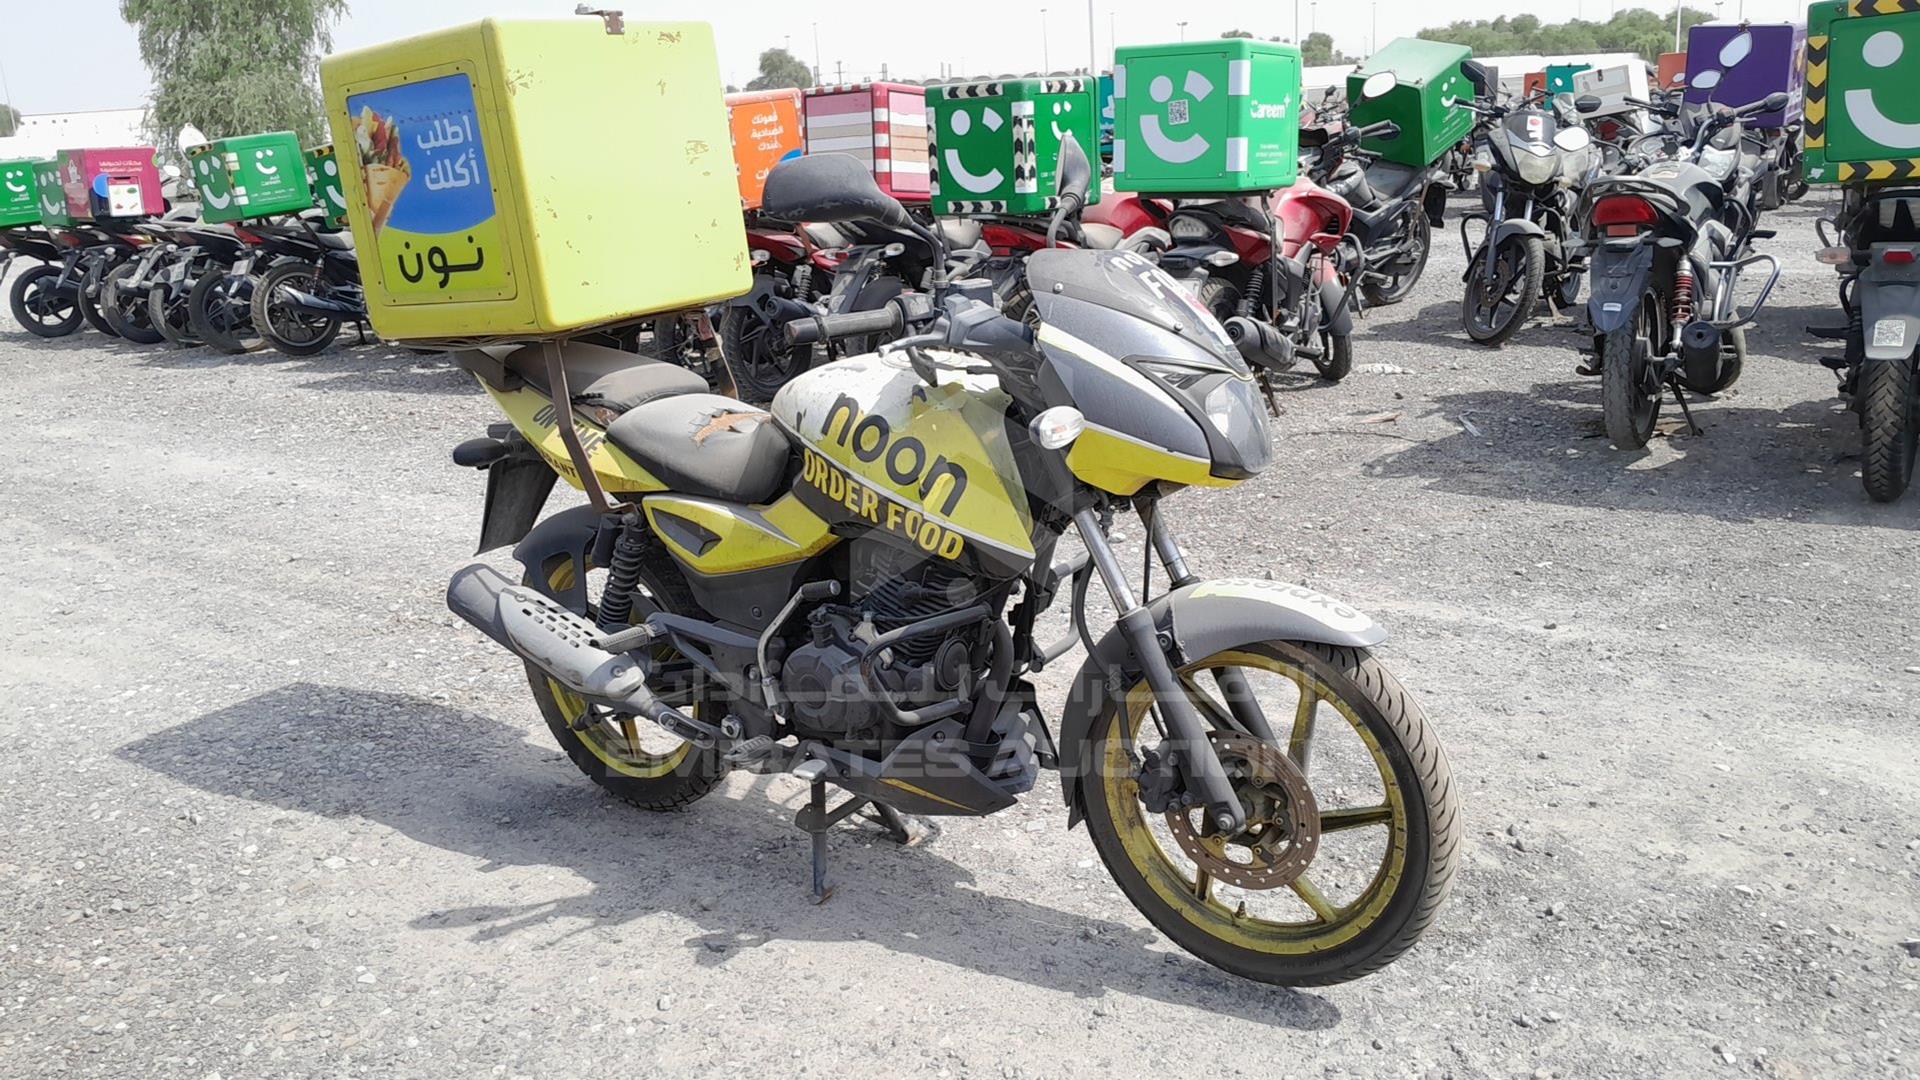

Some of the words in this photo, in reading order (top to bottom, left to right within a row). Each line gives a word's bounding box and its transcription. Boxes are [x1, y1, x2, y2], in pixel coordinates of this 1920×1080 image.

[417, 115, 472, 156] اطلب
[425, 148, 480, 191] أكلك
[398, 235, 484, 289] نون
[821, 392, 968, 518] noon
[803, 447, 879, 524] ORDER
[886, 502, 965, 561] FOOD
